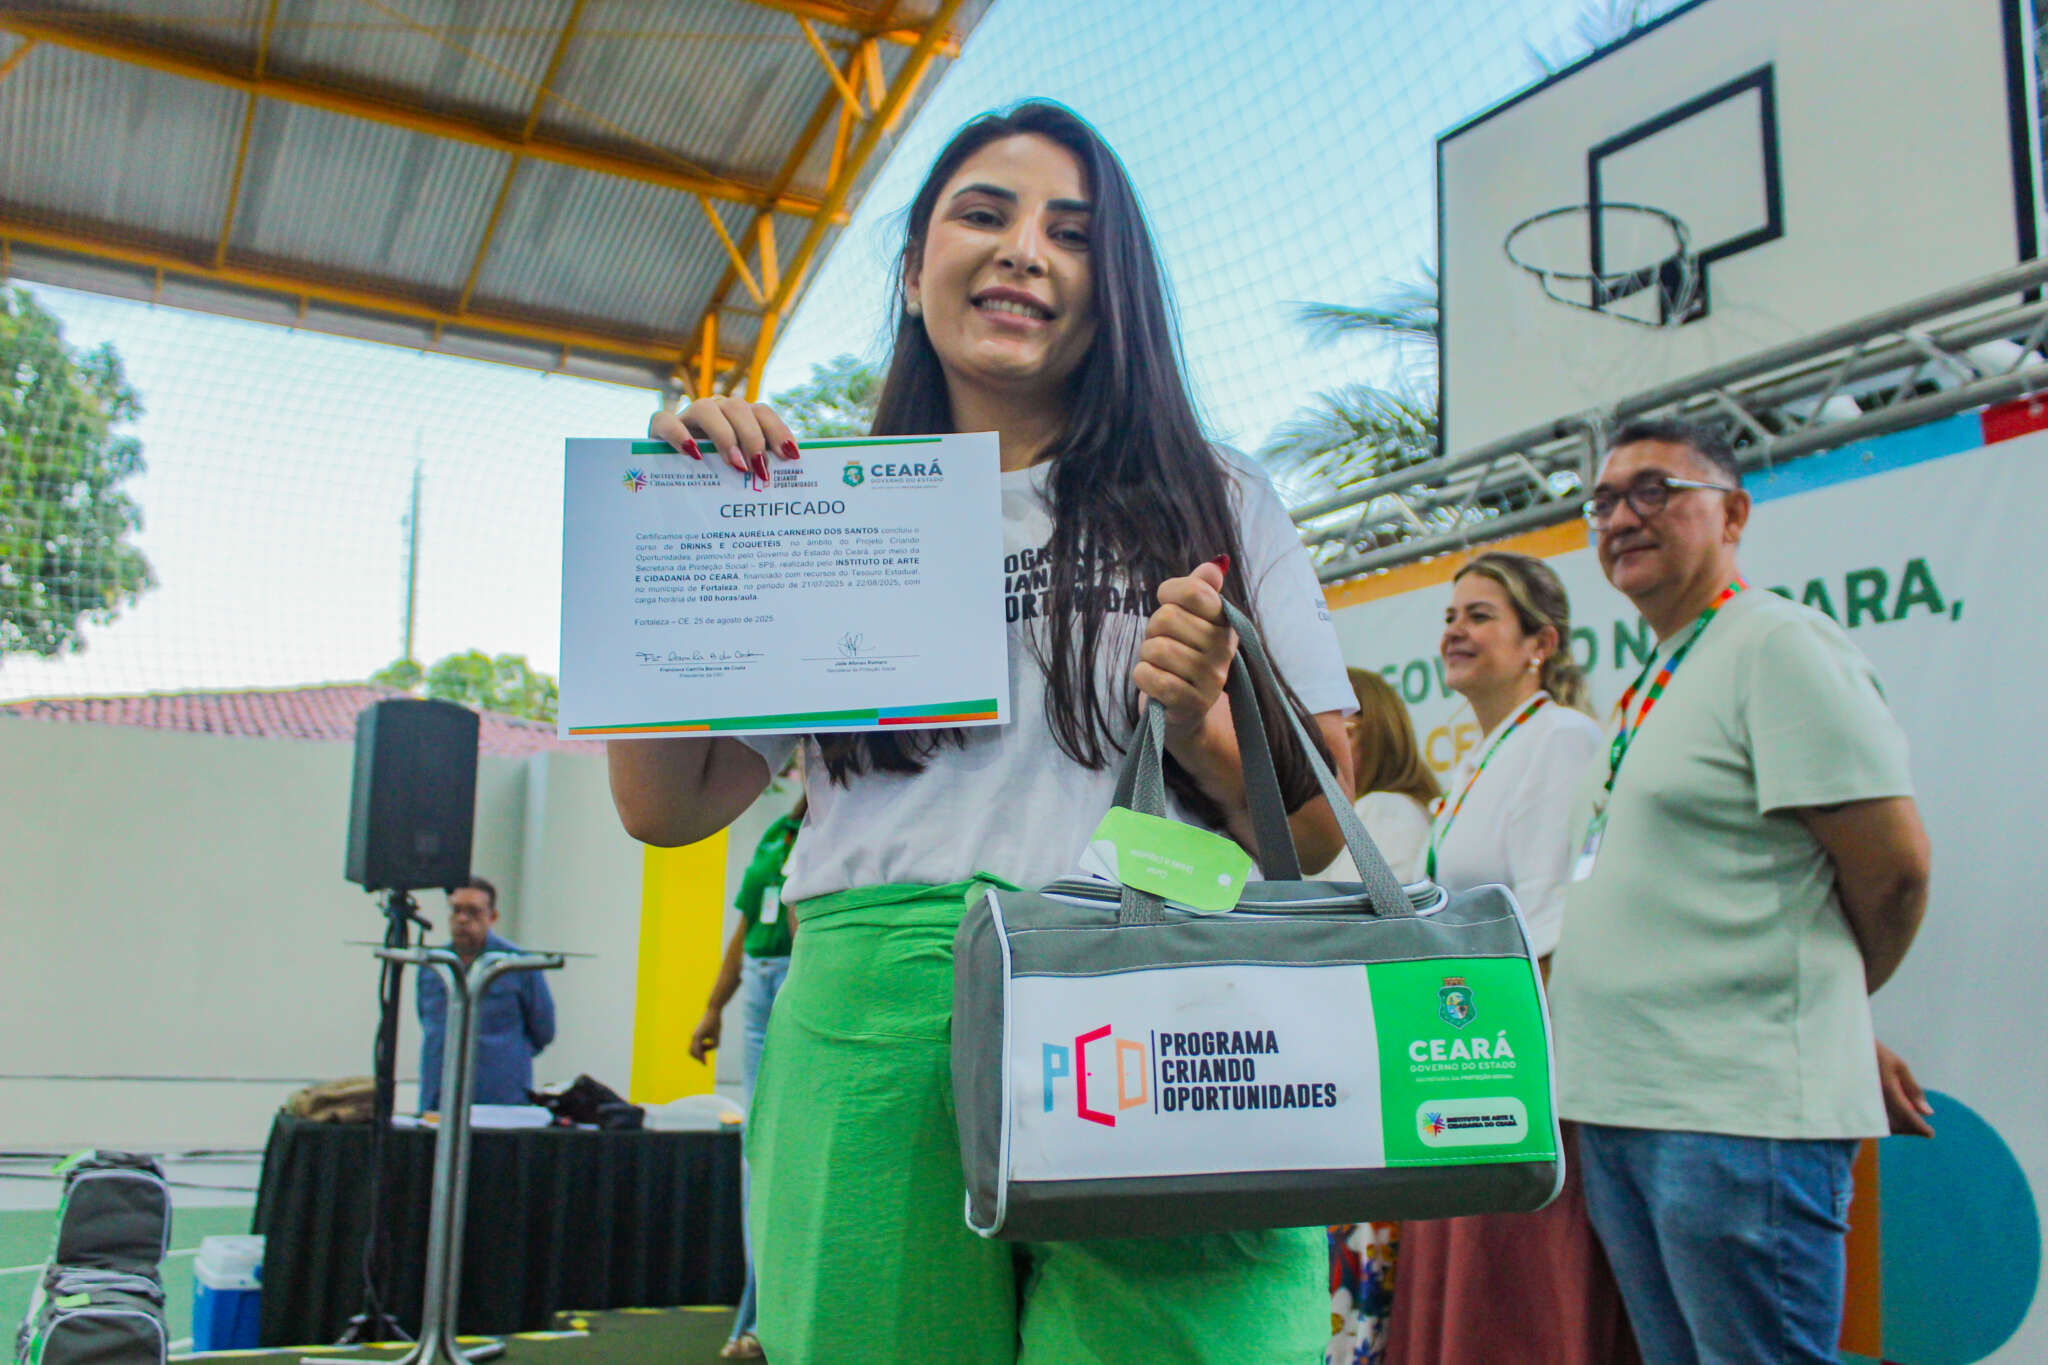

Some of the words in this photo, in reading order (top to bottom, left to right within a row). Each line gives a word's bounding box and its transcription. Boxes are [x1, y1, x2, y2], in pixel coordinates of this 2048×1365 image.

[871, 458, 943, 477] CEARÁ
[720, 500, 846, 518] CERTIFICADO
[701, 531, 736, 540] LORENA
[777, 528, 822, 537] CARNEIRO
[824, 527, 842, 536] DOS
[844, 527, 879, 536] SANTOS
[680, 542, 713, 550] DRINKS
[719, 541, 726, 549] E
[836, 558, 881, 567] INSTITUTO
[882, 557, 895, 566] DE
[897, 557, 920, 565] ARTE
[635, 574, 641, 582] E
[644, 574, 691, 582] CIDADANIA
[693, 573, 707, 581] DO
[699, 594, 713, 602] 100
[1764, 556, 1965, 629] ARA,
[634, 617, 670, 627] Fortaleza
[1160, 1030, 1280, 1057] PROGRAMA
[1409, 1030, 1515, 1062] CEARÁ
[1161, 1058, 1256, 1084] CRIANDO
[1410, 1063, 1459, 1072] GOVERNO
[1461, 1062, 1477, 1070] DO
[1478, 1061, 1517, 1070] ESTADO
[1163, 1082, 1337, 1112] OPORTUNIDADES
